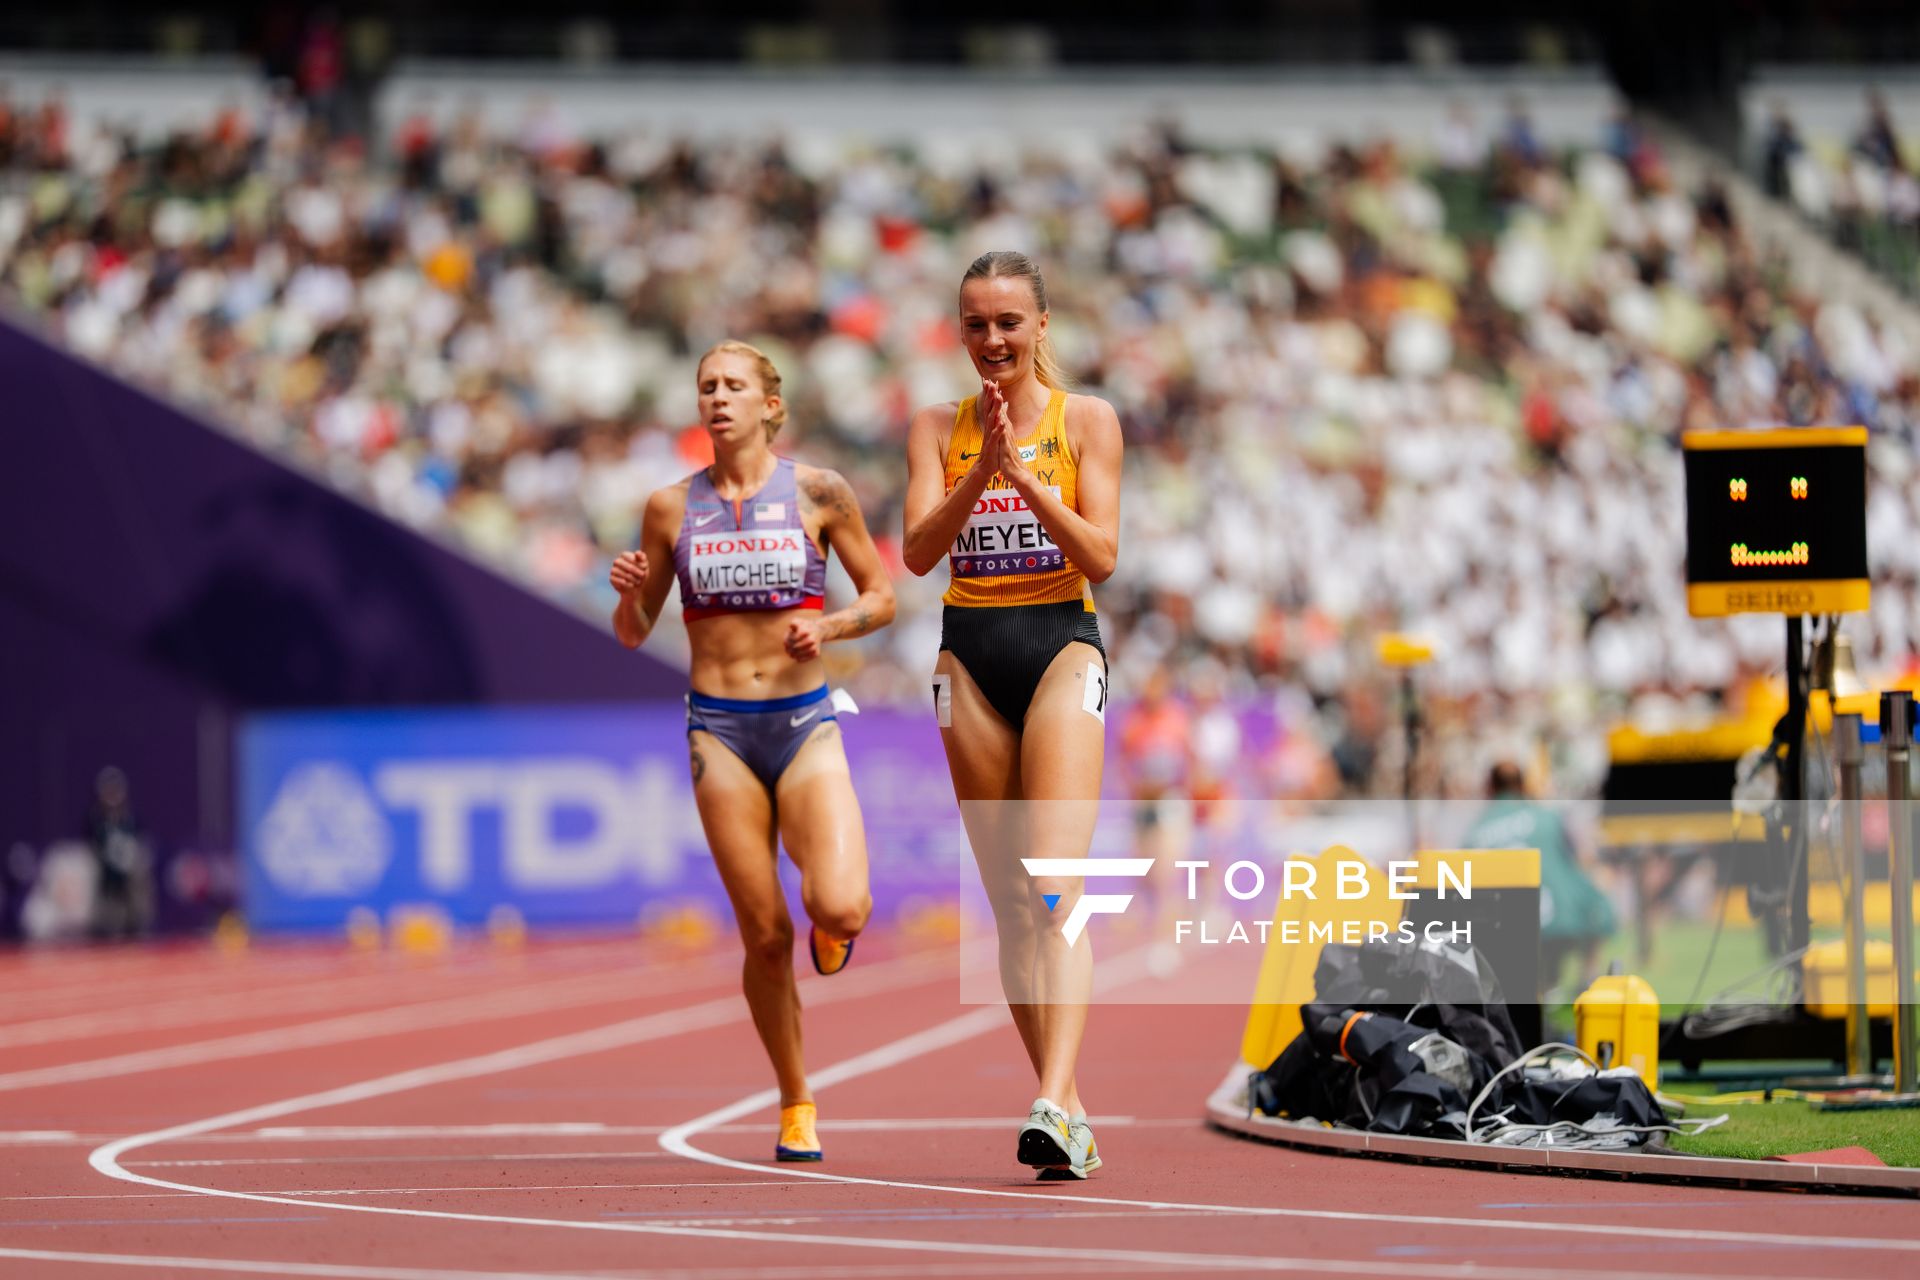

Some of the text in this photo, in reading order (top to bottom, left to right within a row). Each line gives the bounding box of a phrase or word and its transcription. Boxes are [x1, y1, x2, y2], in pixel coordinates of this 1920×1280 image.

[971, 496, 1030, 515] OND
[694, 537, 800, 556] HONDA
[696, 562, 799, 590] MITCHELL
[1726, 588, 1815, 610] SEIKO
